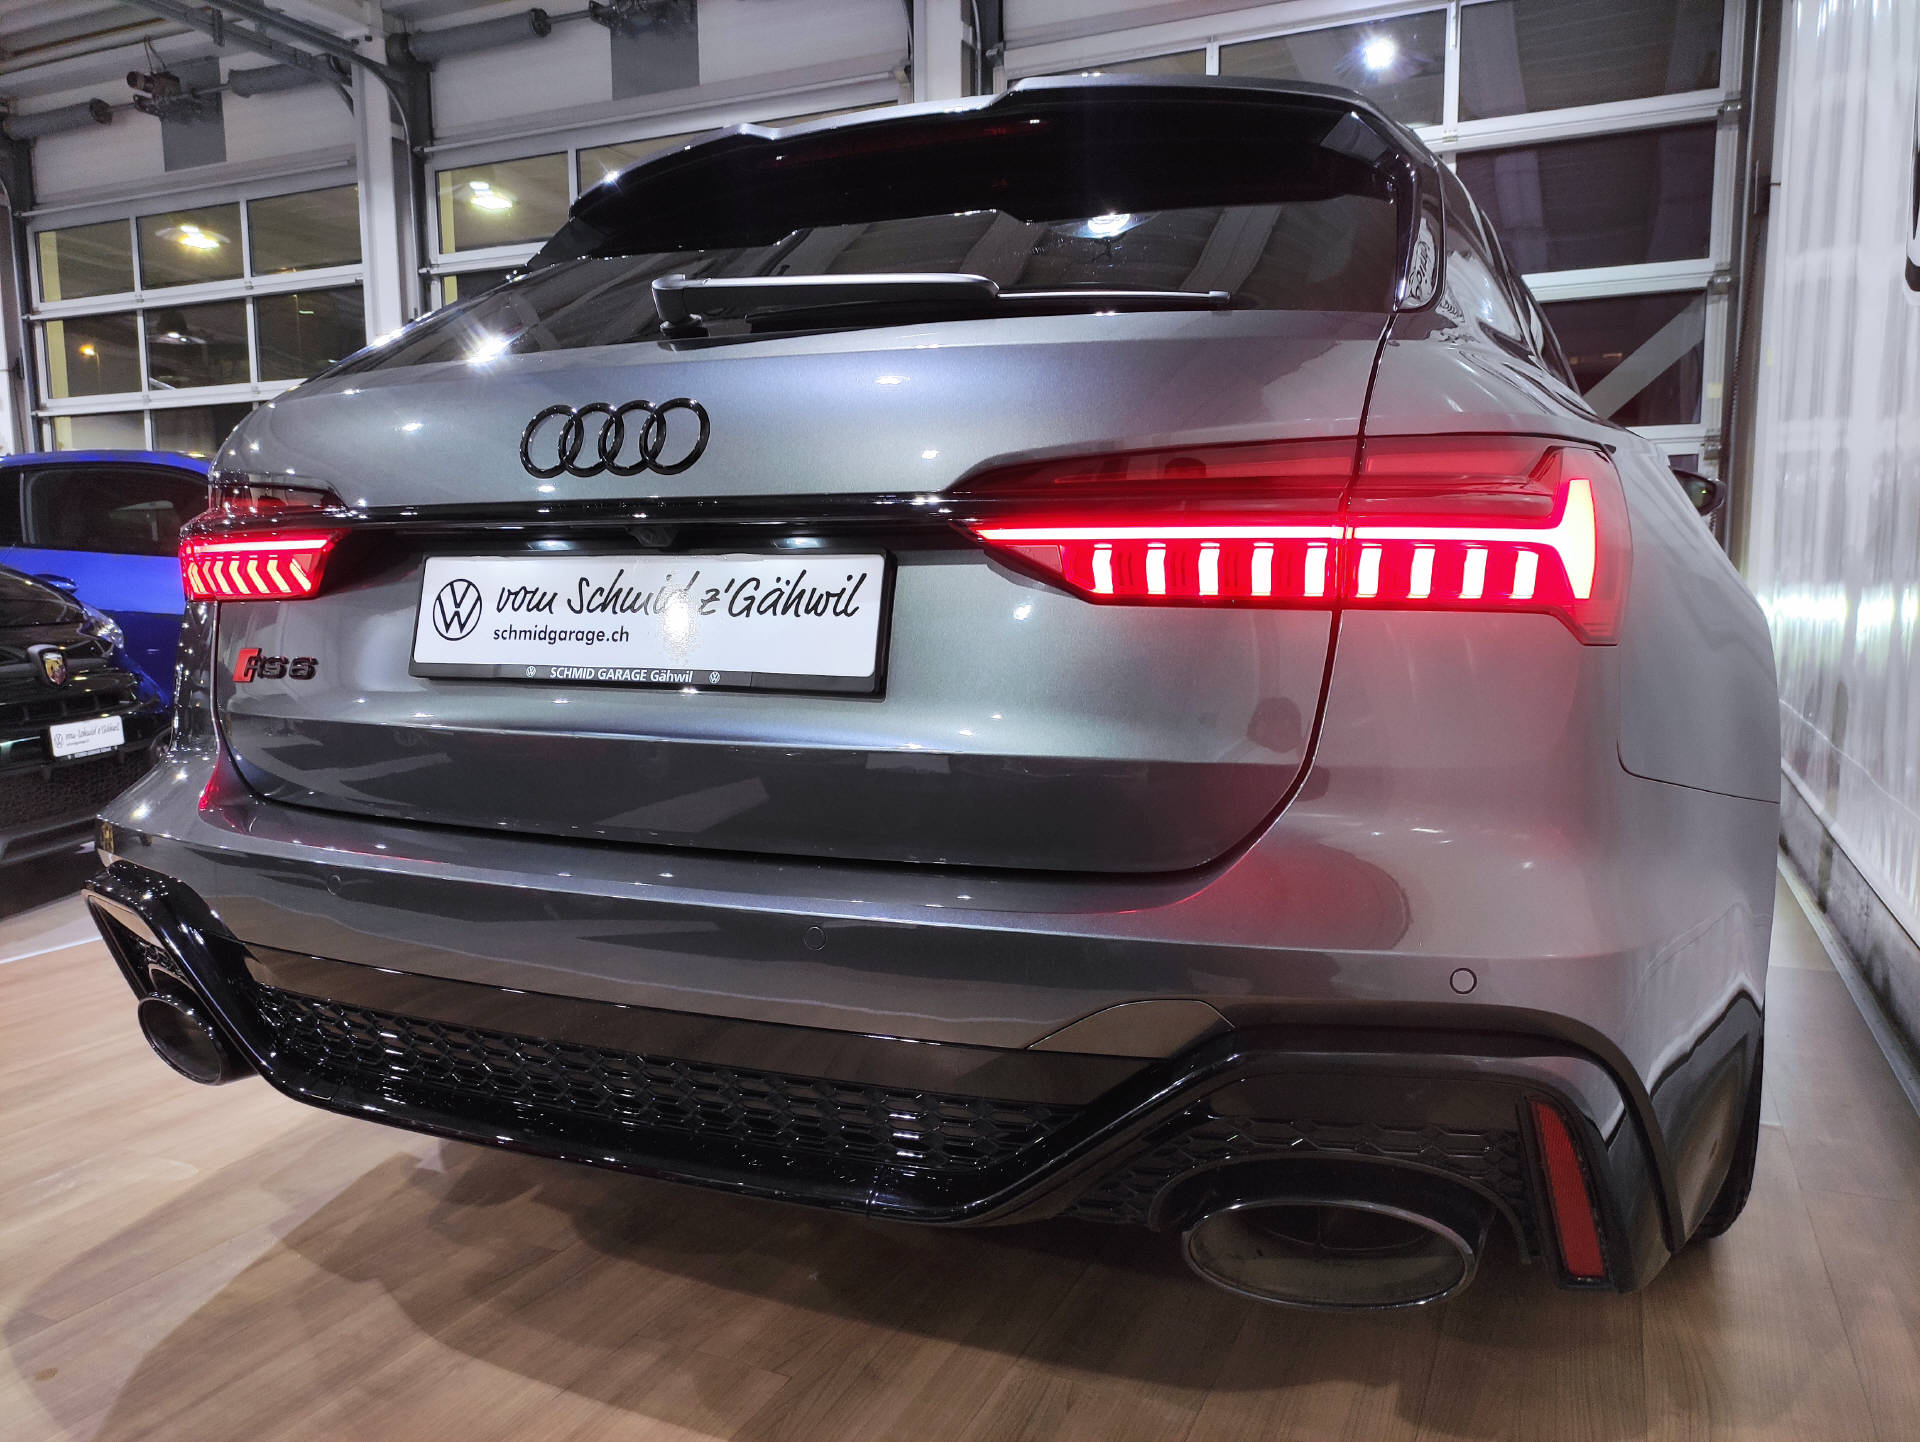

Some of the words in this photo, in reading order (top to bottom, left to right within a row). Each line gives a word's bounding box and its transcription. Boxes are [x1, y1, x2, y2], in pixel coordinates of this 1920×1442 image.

[496, 585, 558, 615] vom
[699, 569, 868, 618] z'Gähwil
[493, 624, 630, 646] schmidgarage.ch
[235, 649, 319, 682] RS6
[550, 666, 595, 681] SCHMID
[597, 668, 648, 682] GARAGE
[650, 669, 694, 683] Gähwil
